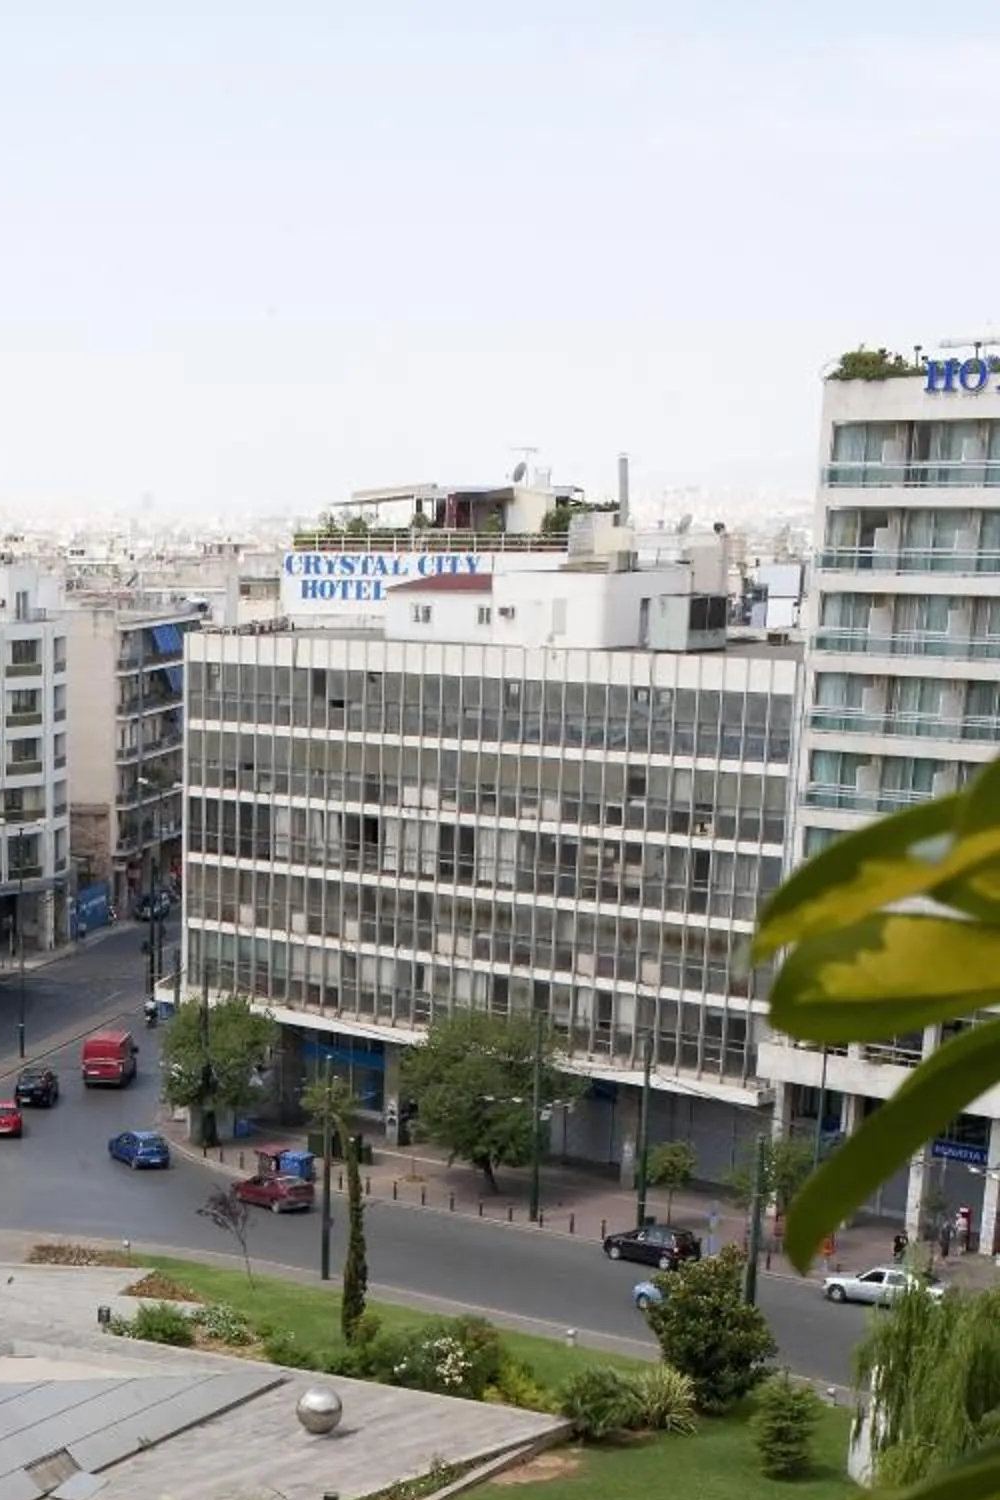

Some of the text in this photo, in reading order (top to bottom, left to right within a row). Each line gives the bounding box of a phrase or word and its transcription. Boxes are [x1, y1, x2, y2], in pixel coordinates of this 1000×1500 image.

[924, 357, 1000, 393] HO
[284, 554, 482, 576] CRYSTAL CITY
[301, 580, 387, 600] HOTEL
